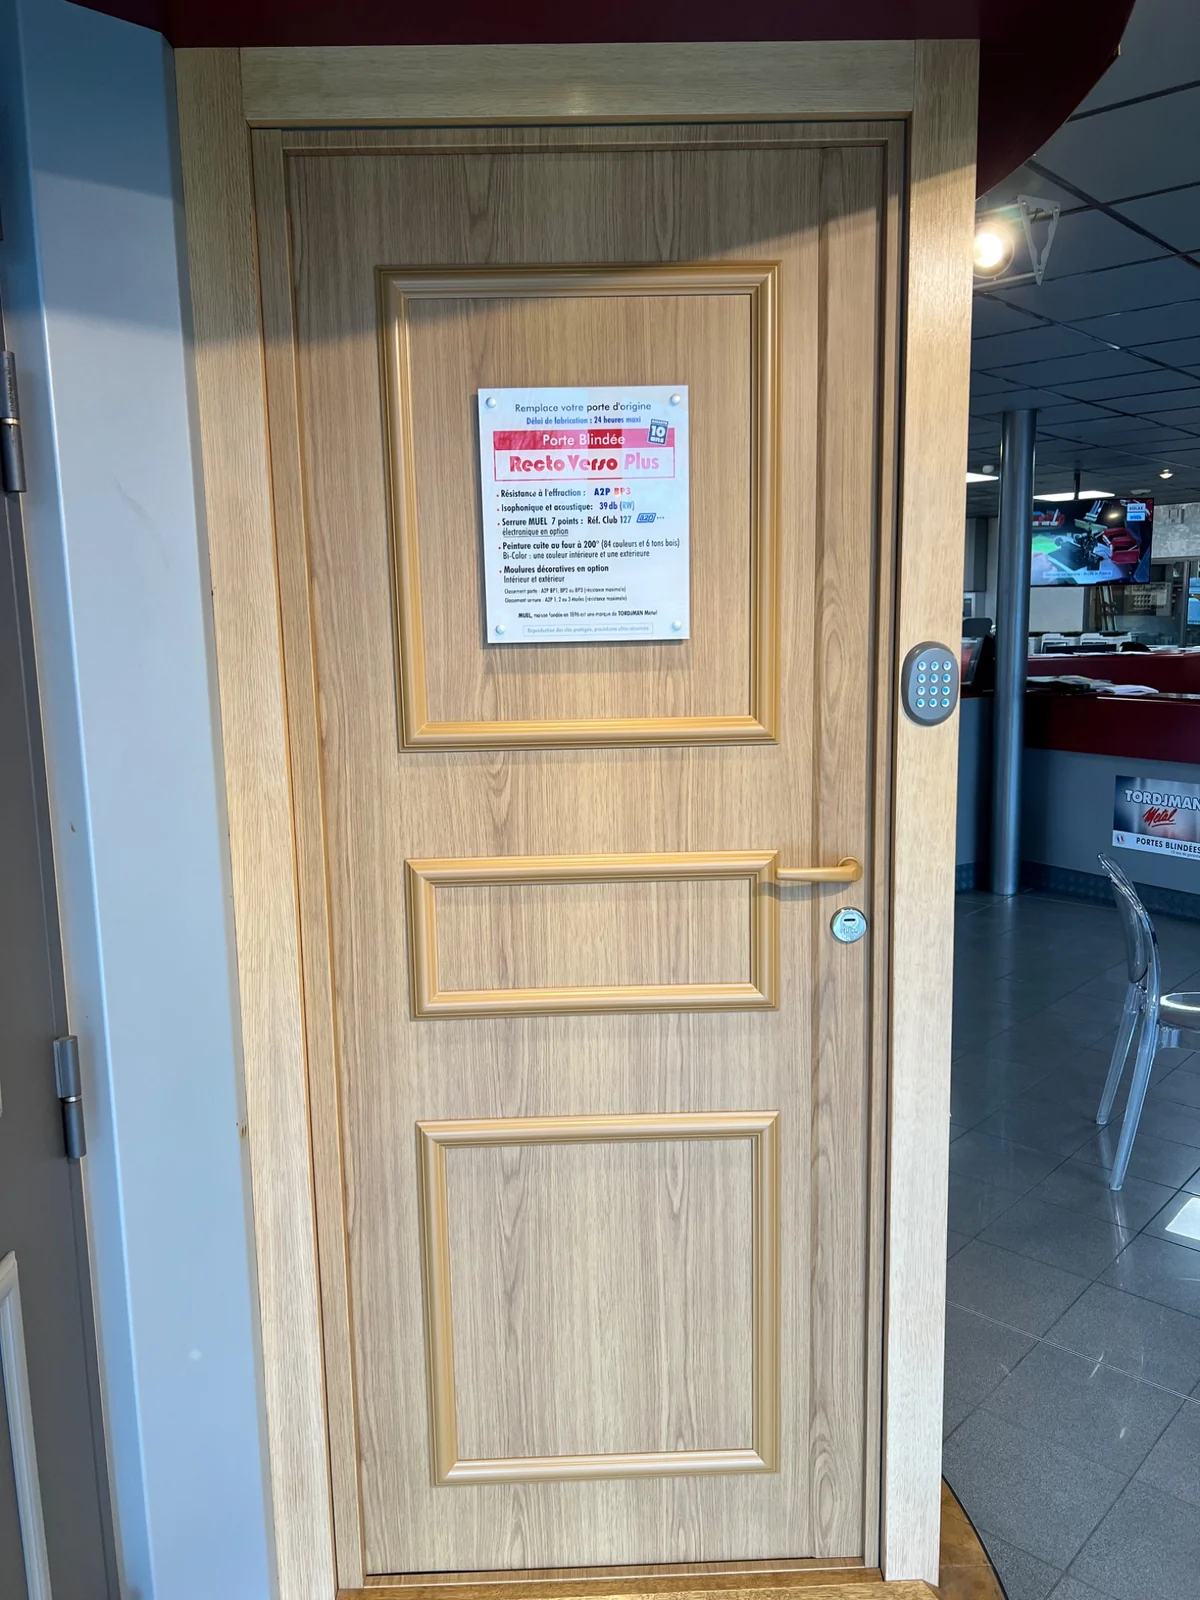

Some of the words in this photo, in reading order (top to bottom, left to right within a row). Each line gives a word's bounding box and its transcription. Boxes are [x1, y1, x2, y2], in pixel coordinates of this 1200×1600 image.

[515, 403, 559, 414] Remplace
[560, 404, 584, 412] votre
[586, 403, 610, 413] porte
[613, 401, 652, 413] d'origine
[526, 416, 543, 425] Délai
[554, 416, 588, 425] fabrication
[593, 416, 602, 424] 24
[603, 415, 624, 424] heures
[651, 425, 666, 437] 10
[542, 434, 575, 446] Porte
[579, 432, 626, 446] Blindée
[509, 455, 565, 472] Recto
[567, 454, 618, 471] Verso
[624, 452, 660, 470] Plus
[500, 488, 537, 498] Résistance
[538, 488, 543, 497] à
[544, 487, 582, 497] l'effraction
[594, 487, 611, 496] A2P
[613, 487, 631, 496] BP3
[501, 503, 544, 513] Isophonique
[545, 503, 552, 511] et
[599, 501, 608, 510] 39
[608, 501, 618, 510] db
[619, 500, 635, 511] (RW)
[502, 517, 527, 526] Serrure
[528, 517, 548, 526] MUEL
[551, 516, 556, 525] 7
[557, 516, 579, 526] points
[587, 515, 601, 525] Réf.
[602, 515, 618, 524] Club
[620, 515, 632, 524] 127
[502, 527, 539, 537] électronique
[549, 527, 569, 537] option
[502, 541, 531, 550] Peinture
[532, 541, 550, 549] cuite
[561, 540, 576, 549] four
[577, 541, 582, 549] à
[583, 540, 600, 549] 200°
[601, 539, 612, 549] (84
[612, 539, 638, 548] couleurs
[638, 540, 645, 548] et
[645, 539, 650, 547] 6
[651, 539, 664, 547] tons
[665, 538, 680, 548] bois)
[502, 551, 527, 560] Bi-Color
[545, 551, 568, 559] couleur
[569, 551, 599, 559] intérieure
[619, 550, 650, 558] extérieure
[503, 565, 536, 574] Moulures
[536, 564, 576, 573] décoratives
[587, 564, 609, 574] option
[503, 575, 530, 583] Intérieur
[530, 575, 537, 583] et
[538, 575, 565, 583] extérieur
[1125, 789, 1200, 811] TORDJMAN
[1142, 806, 1178, 827] Metal
[1136, 837, 1163, 848] PORTES
[1165, 843, 1200, 854] BLINDÉES
